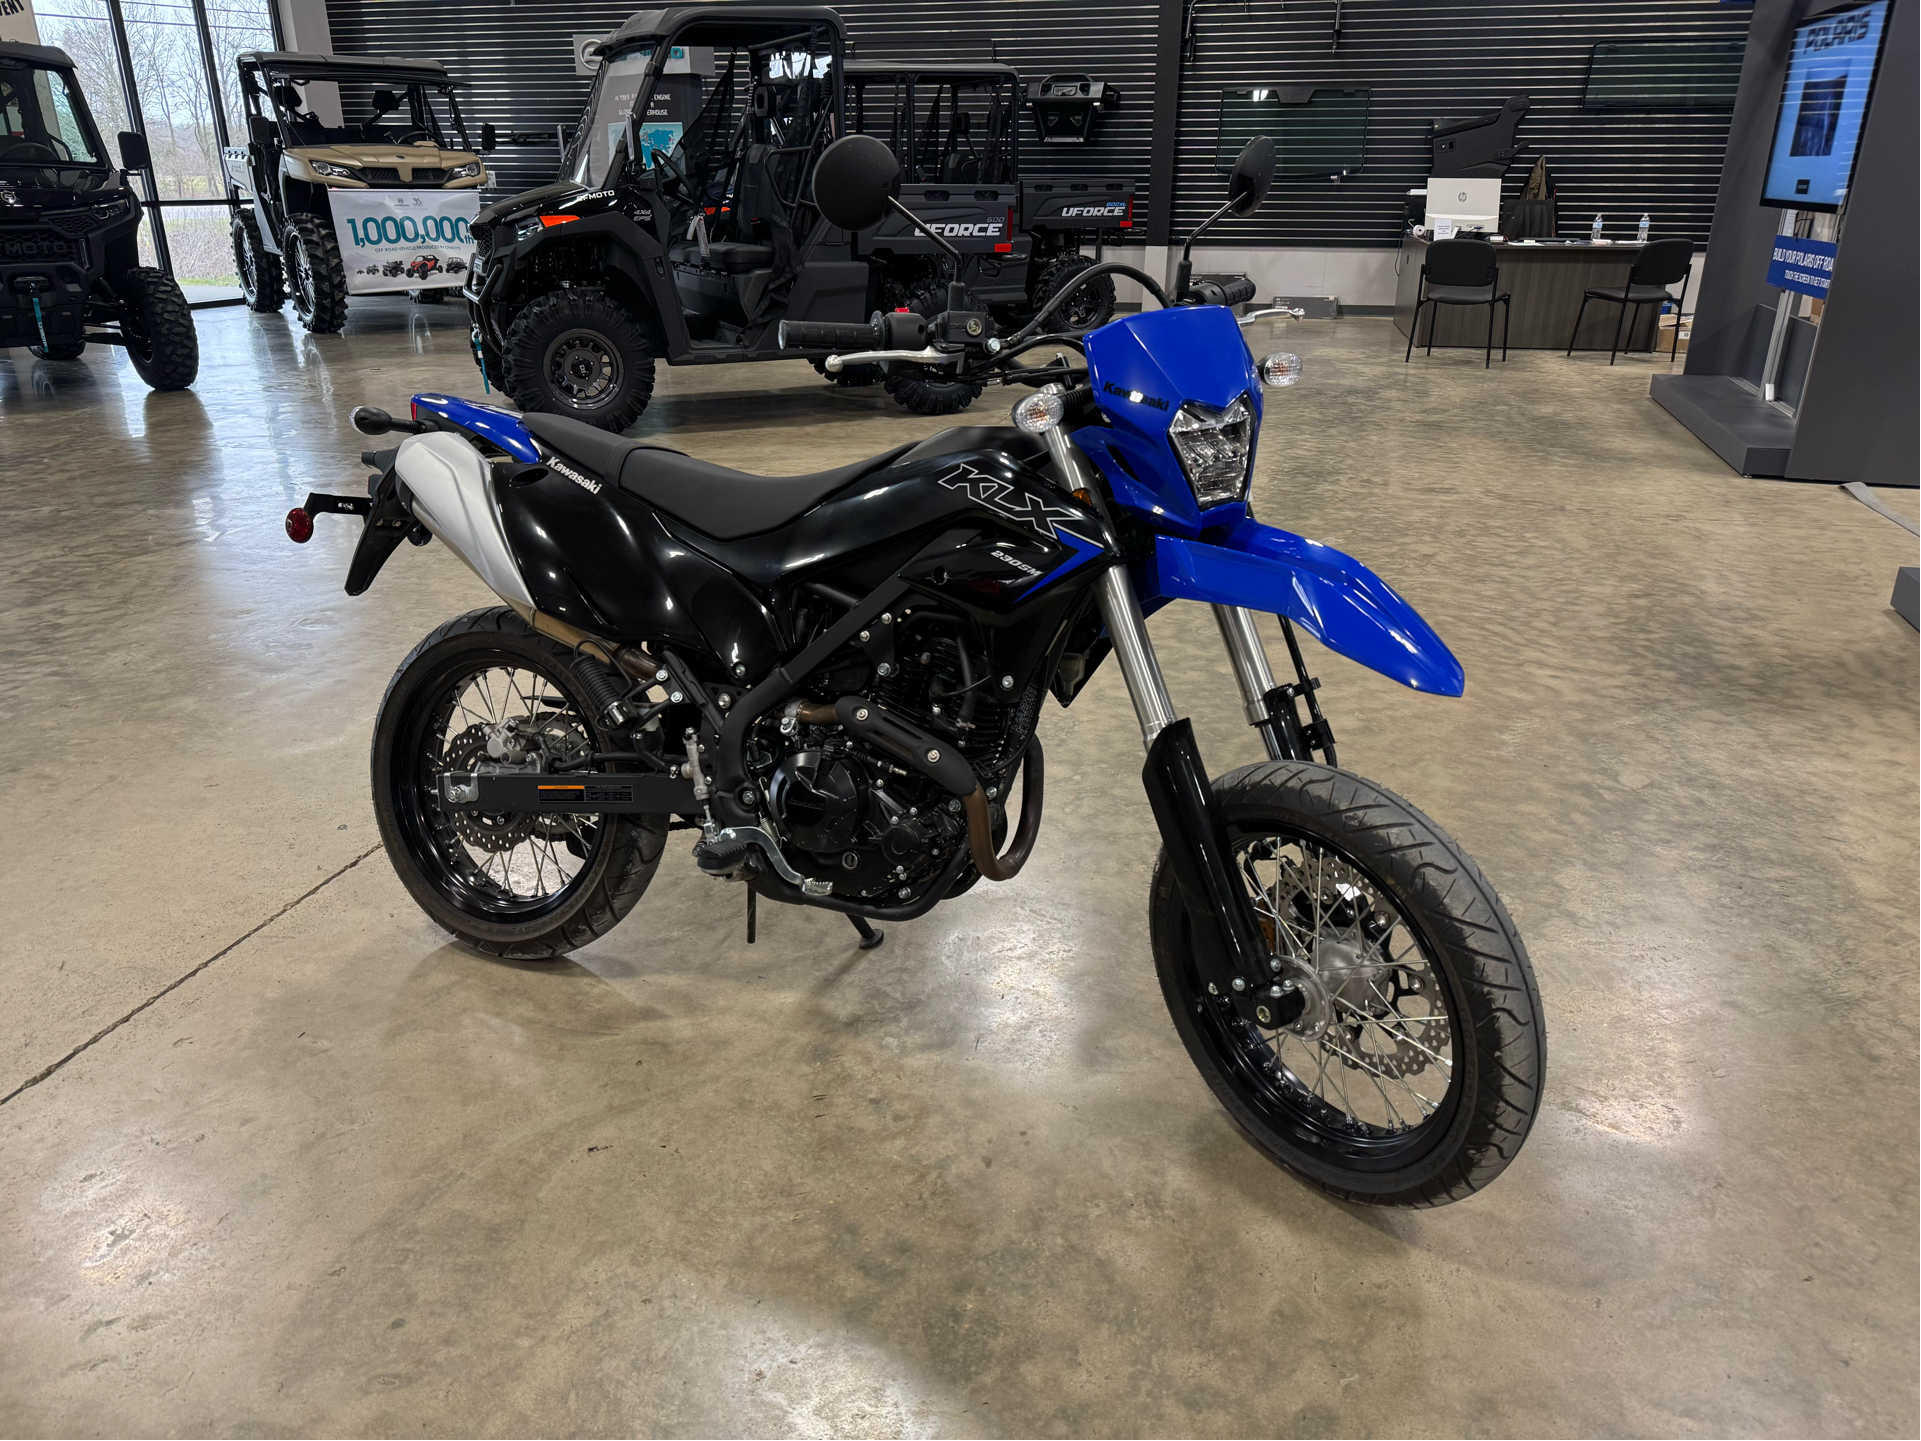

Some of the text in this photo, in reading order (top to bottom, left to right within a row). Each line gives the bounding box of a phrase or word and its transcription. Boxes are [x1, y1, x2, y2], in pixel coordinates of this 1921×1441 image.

[1803, 9, 1872, 55] POLARIS
[653, 93, 671, 101] ENGINE
[1062, 206, 1126, 217] UFORCE
[0, 241, 68, 255] MOTO
[1773, 248, 1834, 272] BUILD YOUR POLARIS OFF ROA
[1103, 381, 1170, 412] Kawsaki
[545, 456, 602, 495] Kawasaki
[937, 462, 1085, 540] KLX
[990, 550, 1043, 577] 230SM
